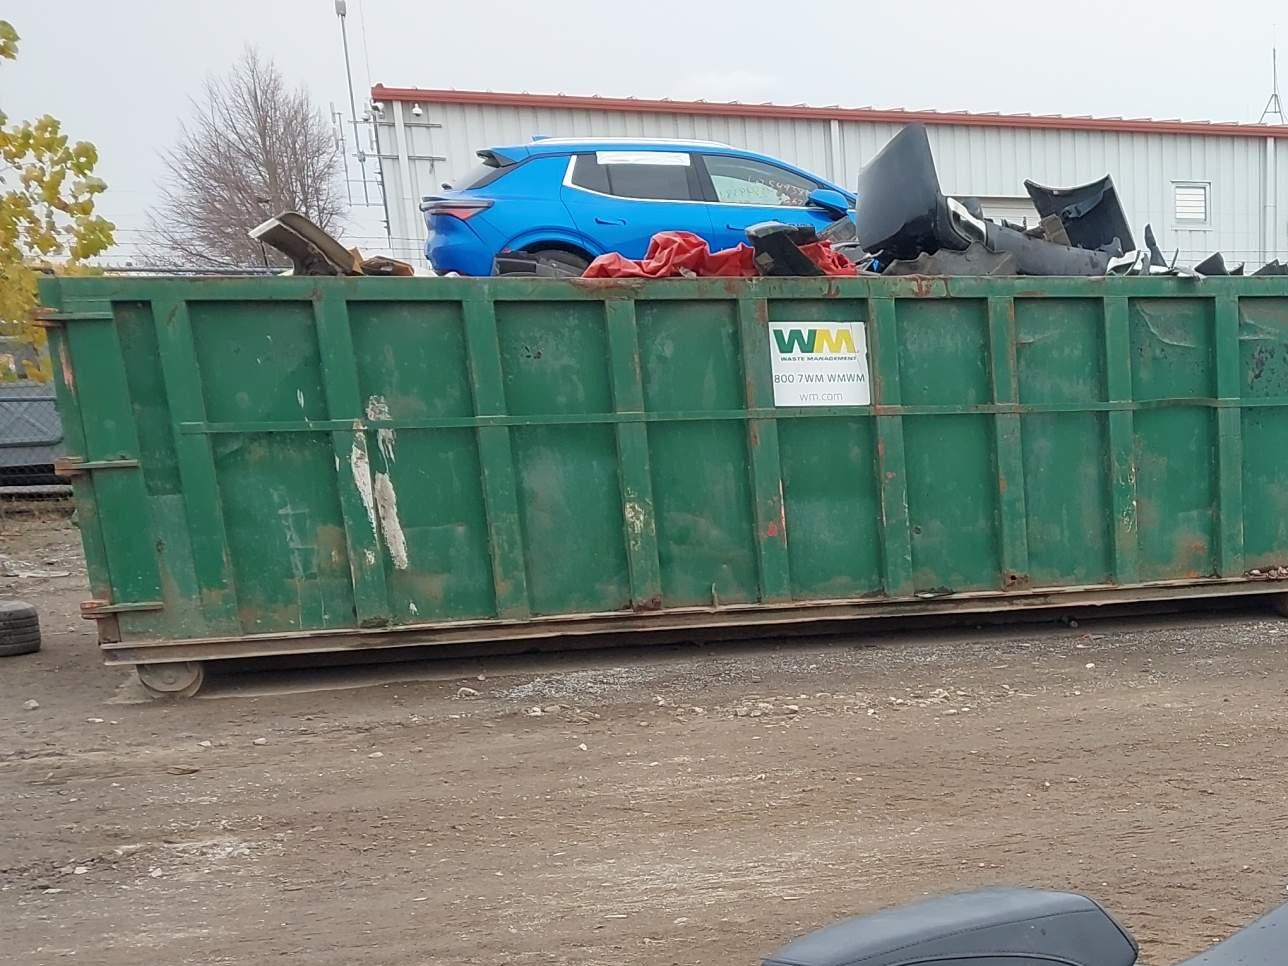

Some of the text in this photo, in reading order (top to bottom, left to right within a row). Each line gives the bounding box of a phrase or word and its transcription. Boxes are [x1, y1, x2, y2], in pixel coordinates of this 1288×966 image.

[773, 329, 856, 353] WM
[774, 373, 865, 384] 800 7WM WMWM
[800, 393, 843, 401] wm.com
